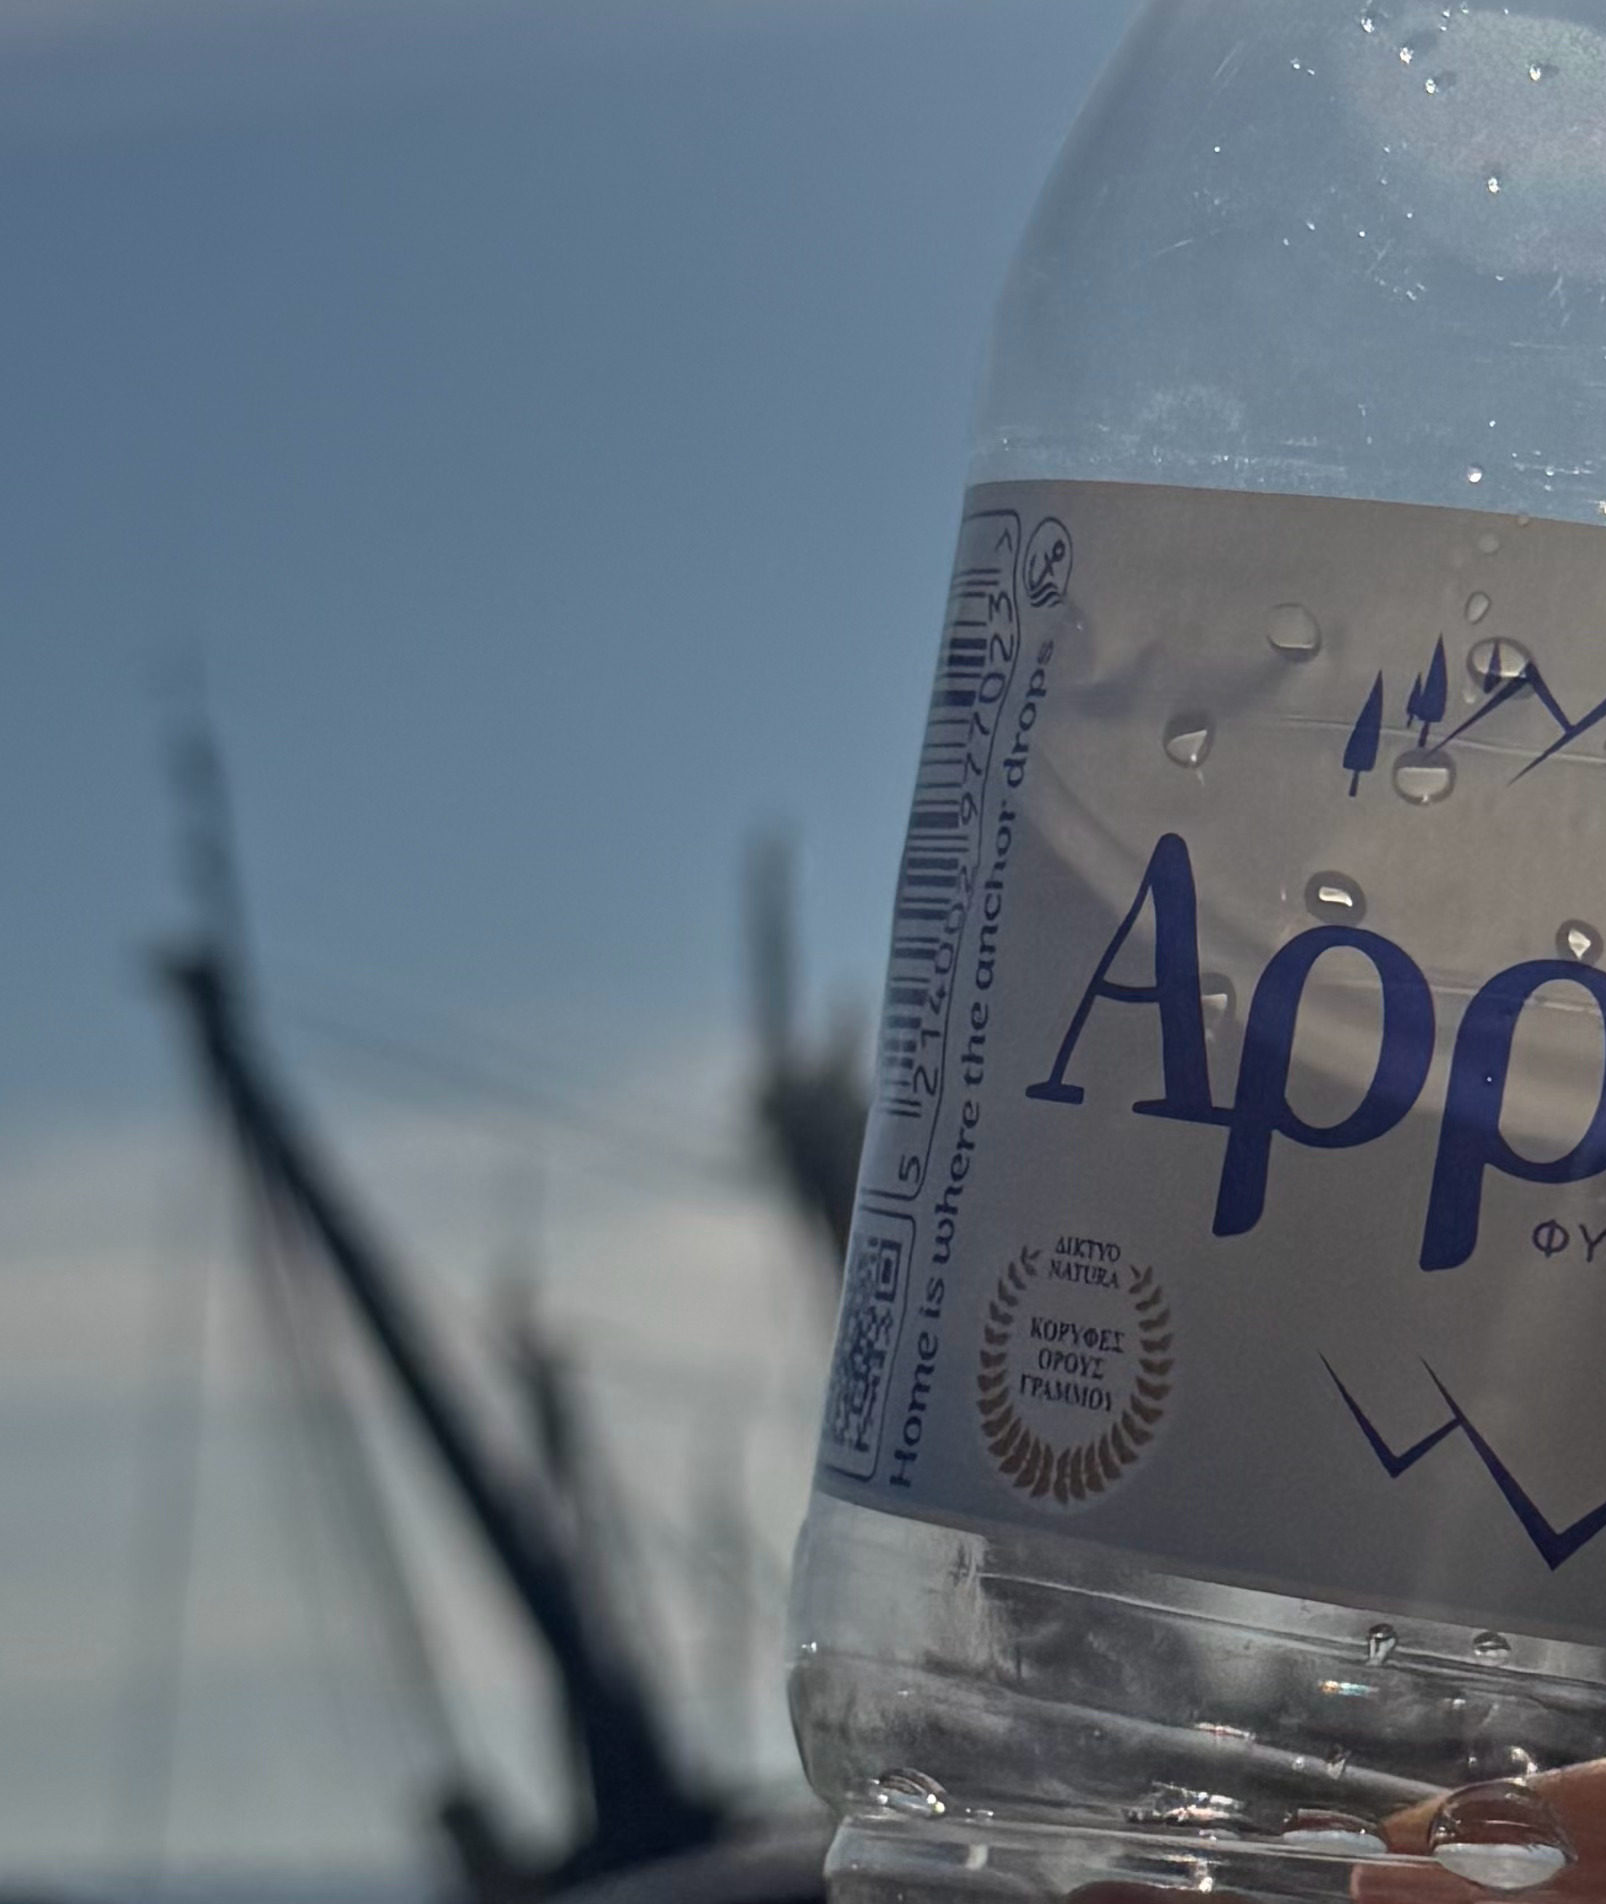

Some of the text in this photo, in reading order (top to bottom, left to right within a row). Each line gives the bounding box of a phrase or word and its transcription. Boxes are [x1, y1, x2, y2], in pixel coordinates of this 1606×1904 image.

[896, 1153, 922, 1183] 5
[957, 589, 1015, 823] 977023
[889, 638, 1054, 1488] Home is where the anchor drops
[1056, 1236, 1121, 1262] ΔΙΚΤΥΟ
[1050, 1259, 1119, 1289] NATURA
[1030, 1316, 1125, 1353] ΚΟΡΥΦΕΣ
[1038, 1347, 1105, 1380] ΟΡΟΥΣ
